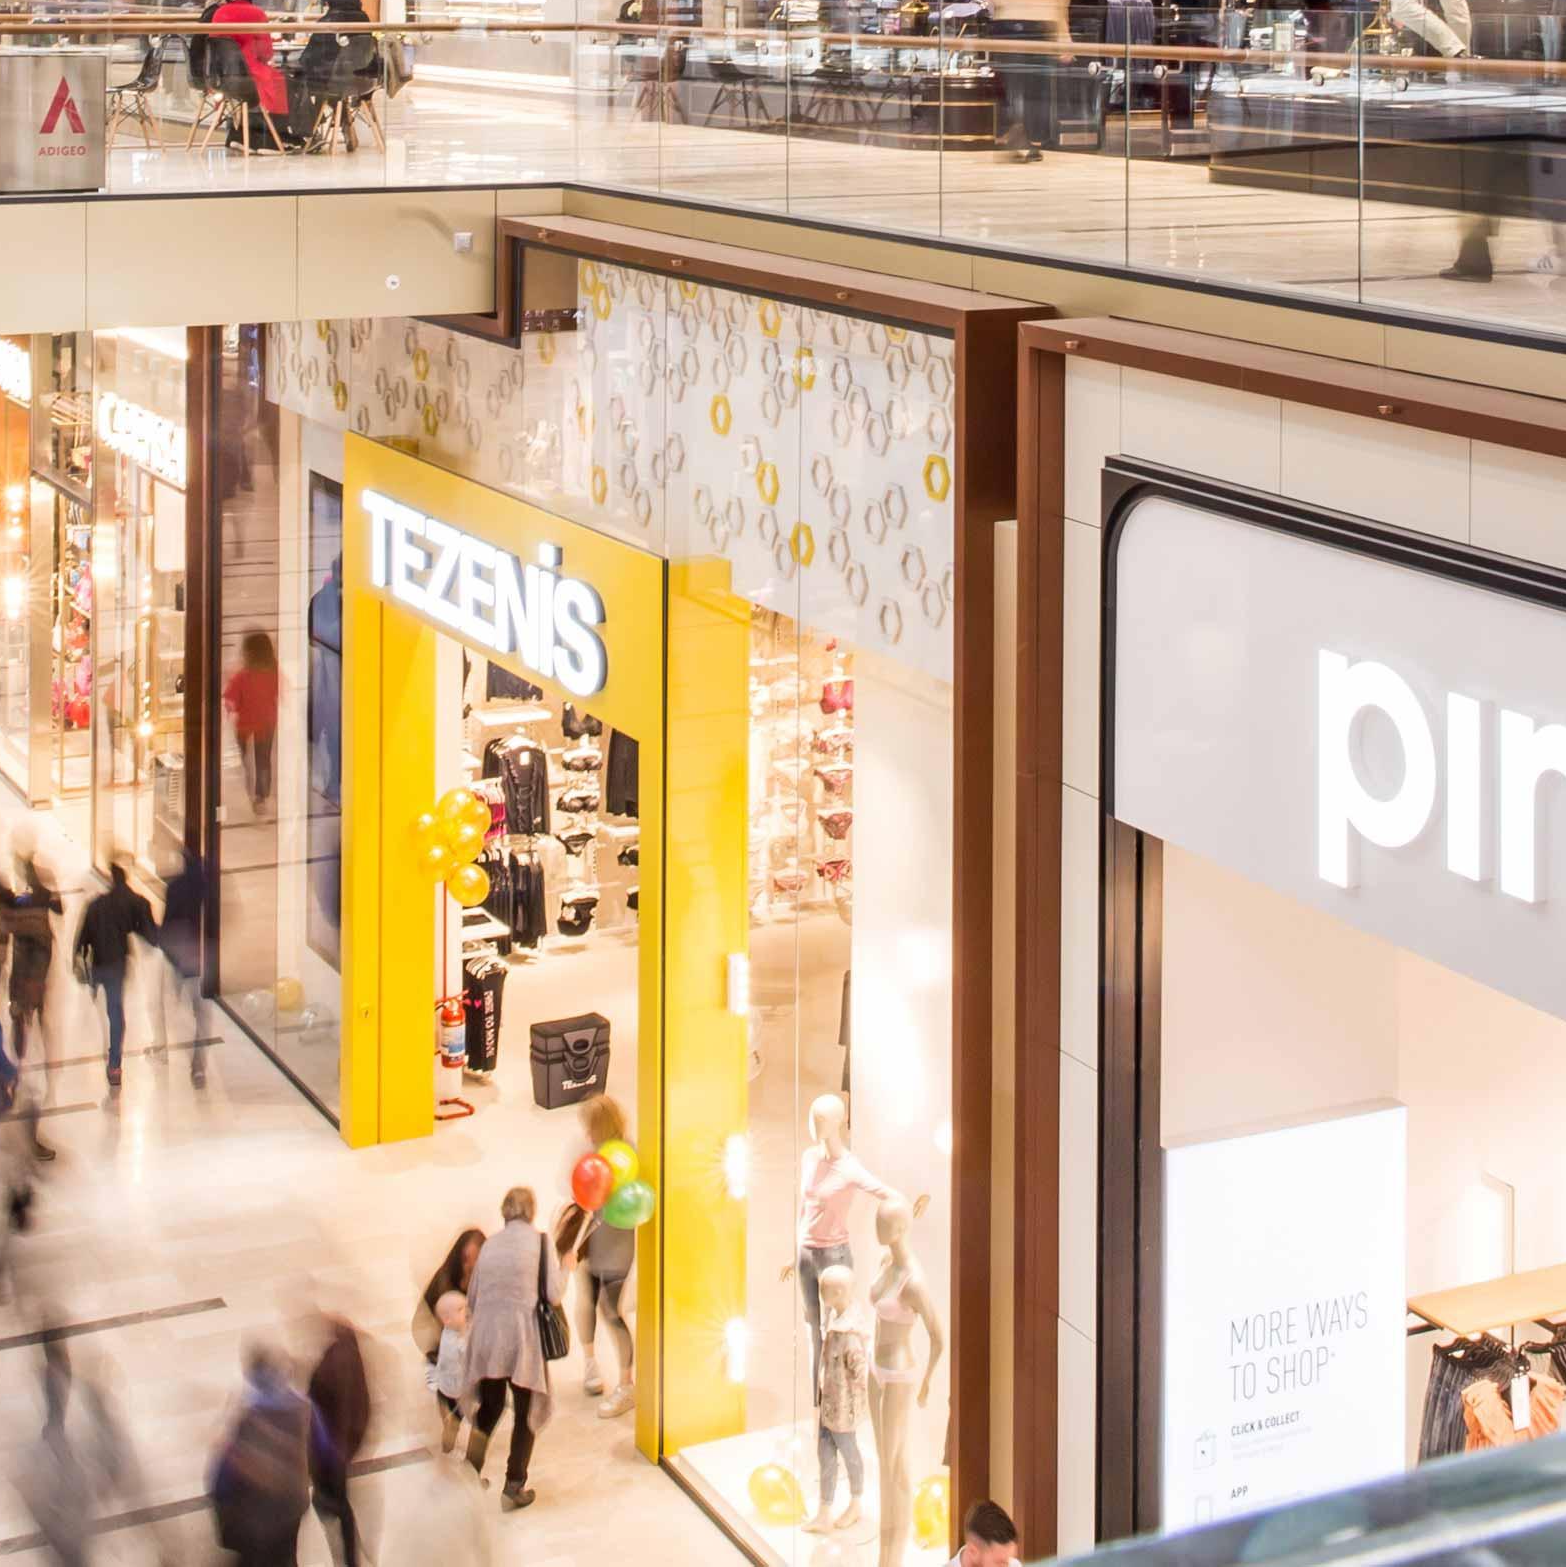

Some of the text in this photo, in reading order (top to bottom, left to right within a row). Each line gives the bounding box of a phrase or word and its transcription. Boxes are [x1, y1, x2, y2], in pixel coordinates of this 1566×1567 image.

[37, 145, 87, 156] ADIGEO
[361, 488, 608, 698] TEZENIS
[1230, 1290, 1368, 1356] MORE WAYS
[1229, 1361, 1257, 1402] TO
[1230, 1410, 1301, 1437] CLICK & COLLECT
[1230, 1485, 1249, 1499] APP
